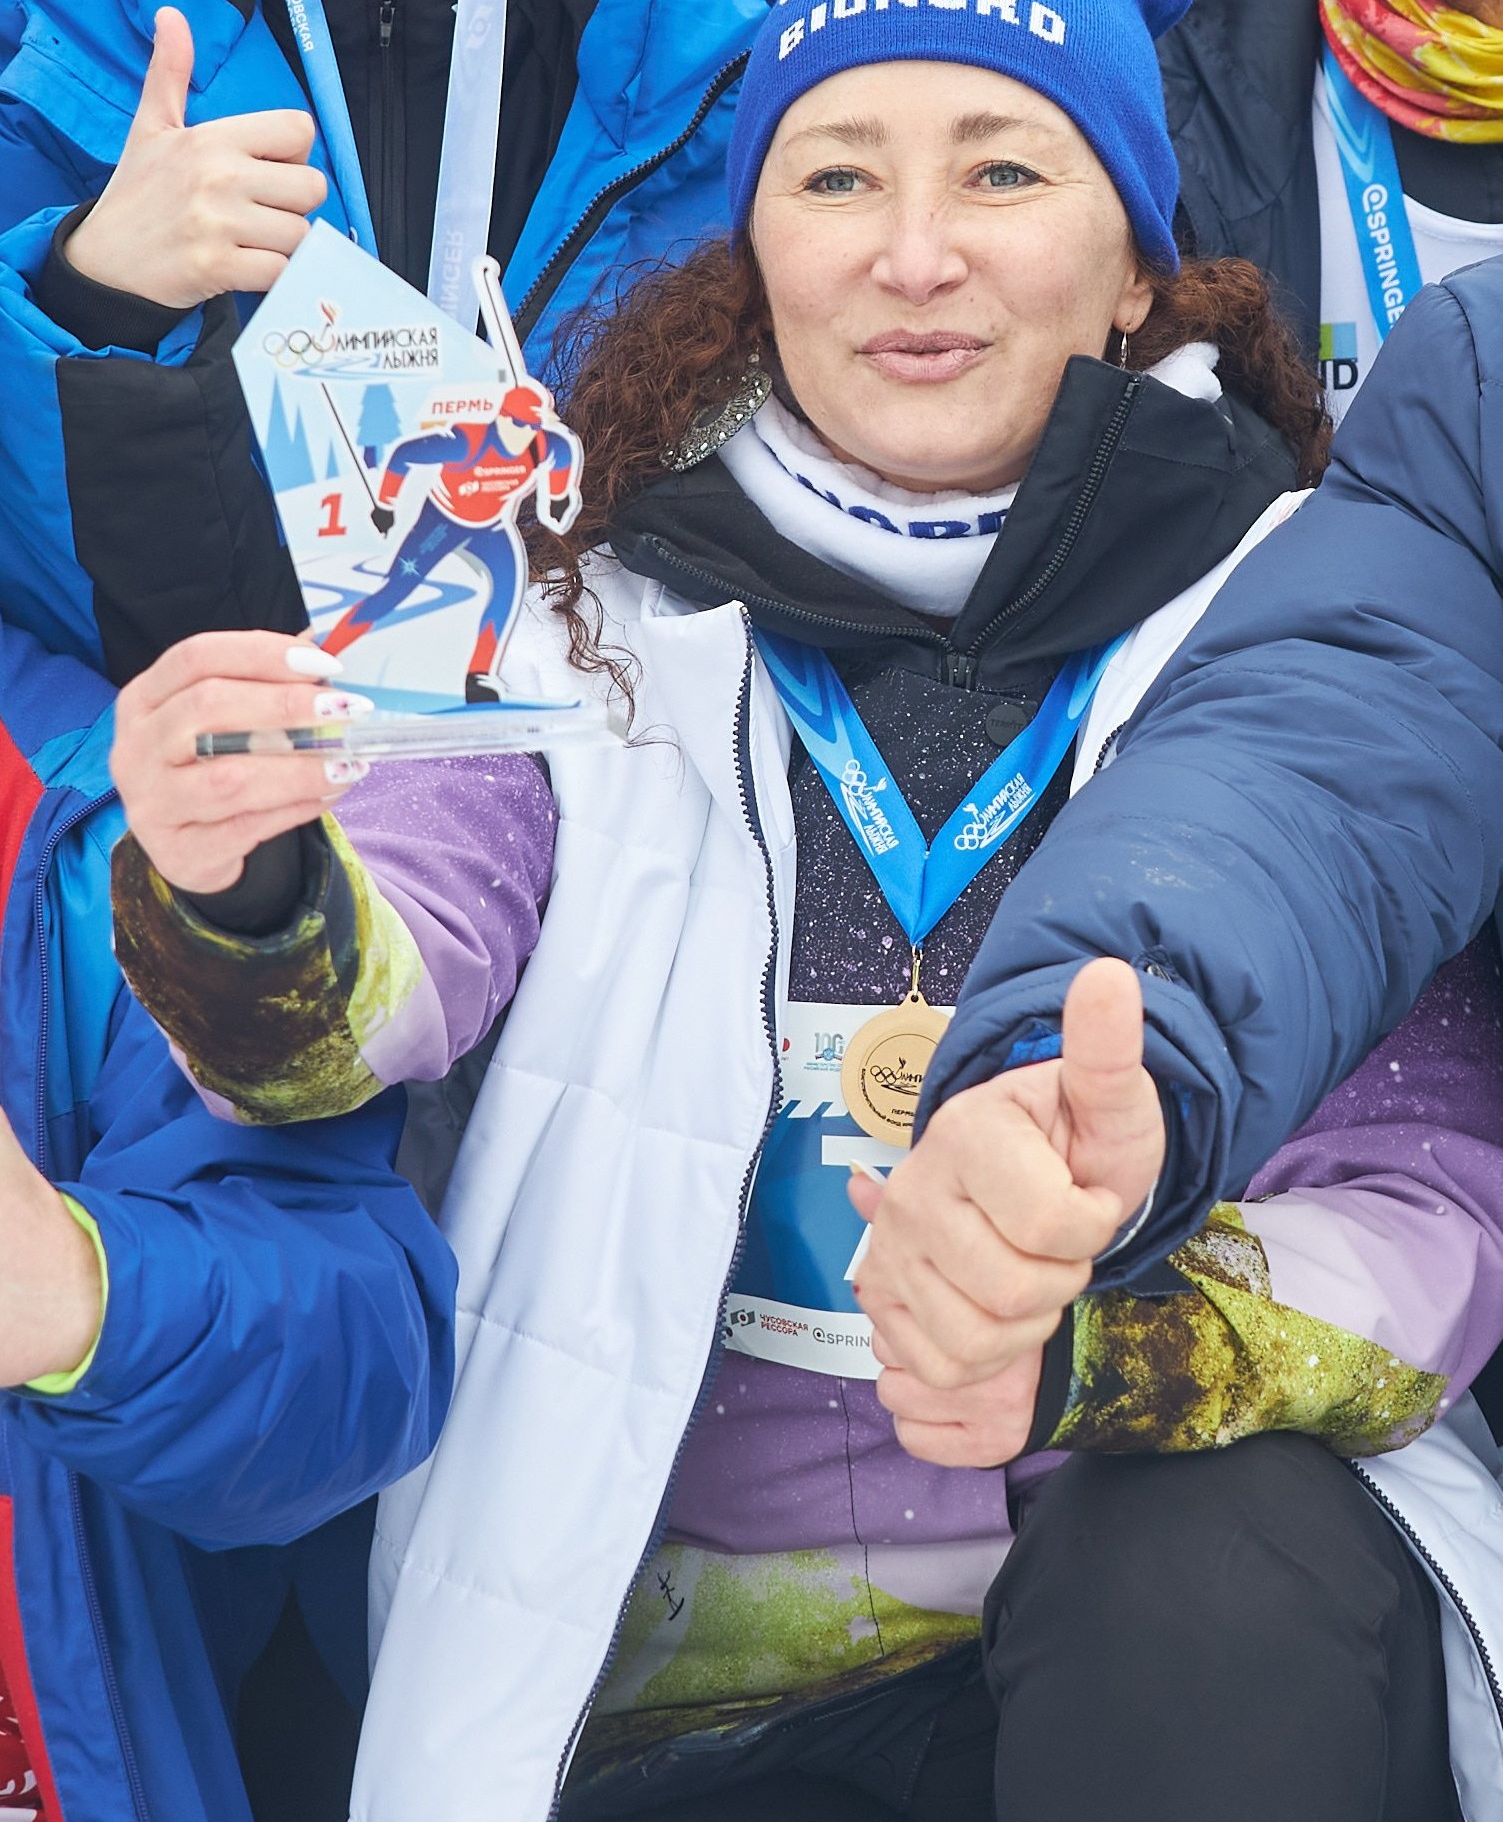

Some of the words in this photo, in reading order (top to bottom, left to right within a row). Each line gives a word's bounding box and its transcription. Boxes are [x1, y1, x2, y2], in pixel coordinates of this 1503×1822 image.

[382, 348, 440, 370] ЛЫЖНЯ
[431, 397, 494, 415] ПЕРМЬ
[317, 492, 348, 539] 1
[759, 1313, 809, 1331] ЧУСОВСКАЯ
[760, 1321, 799, 1337] РЕССОРА
